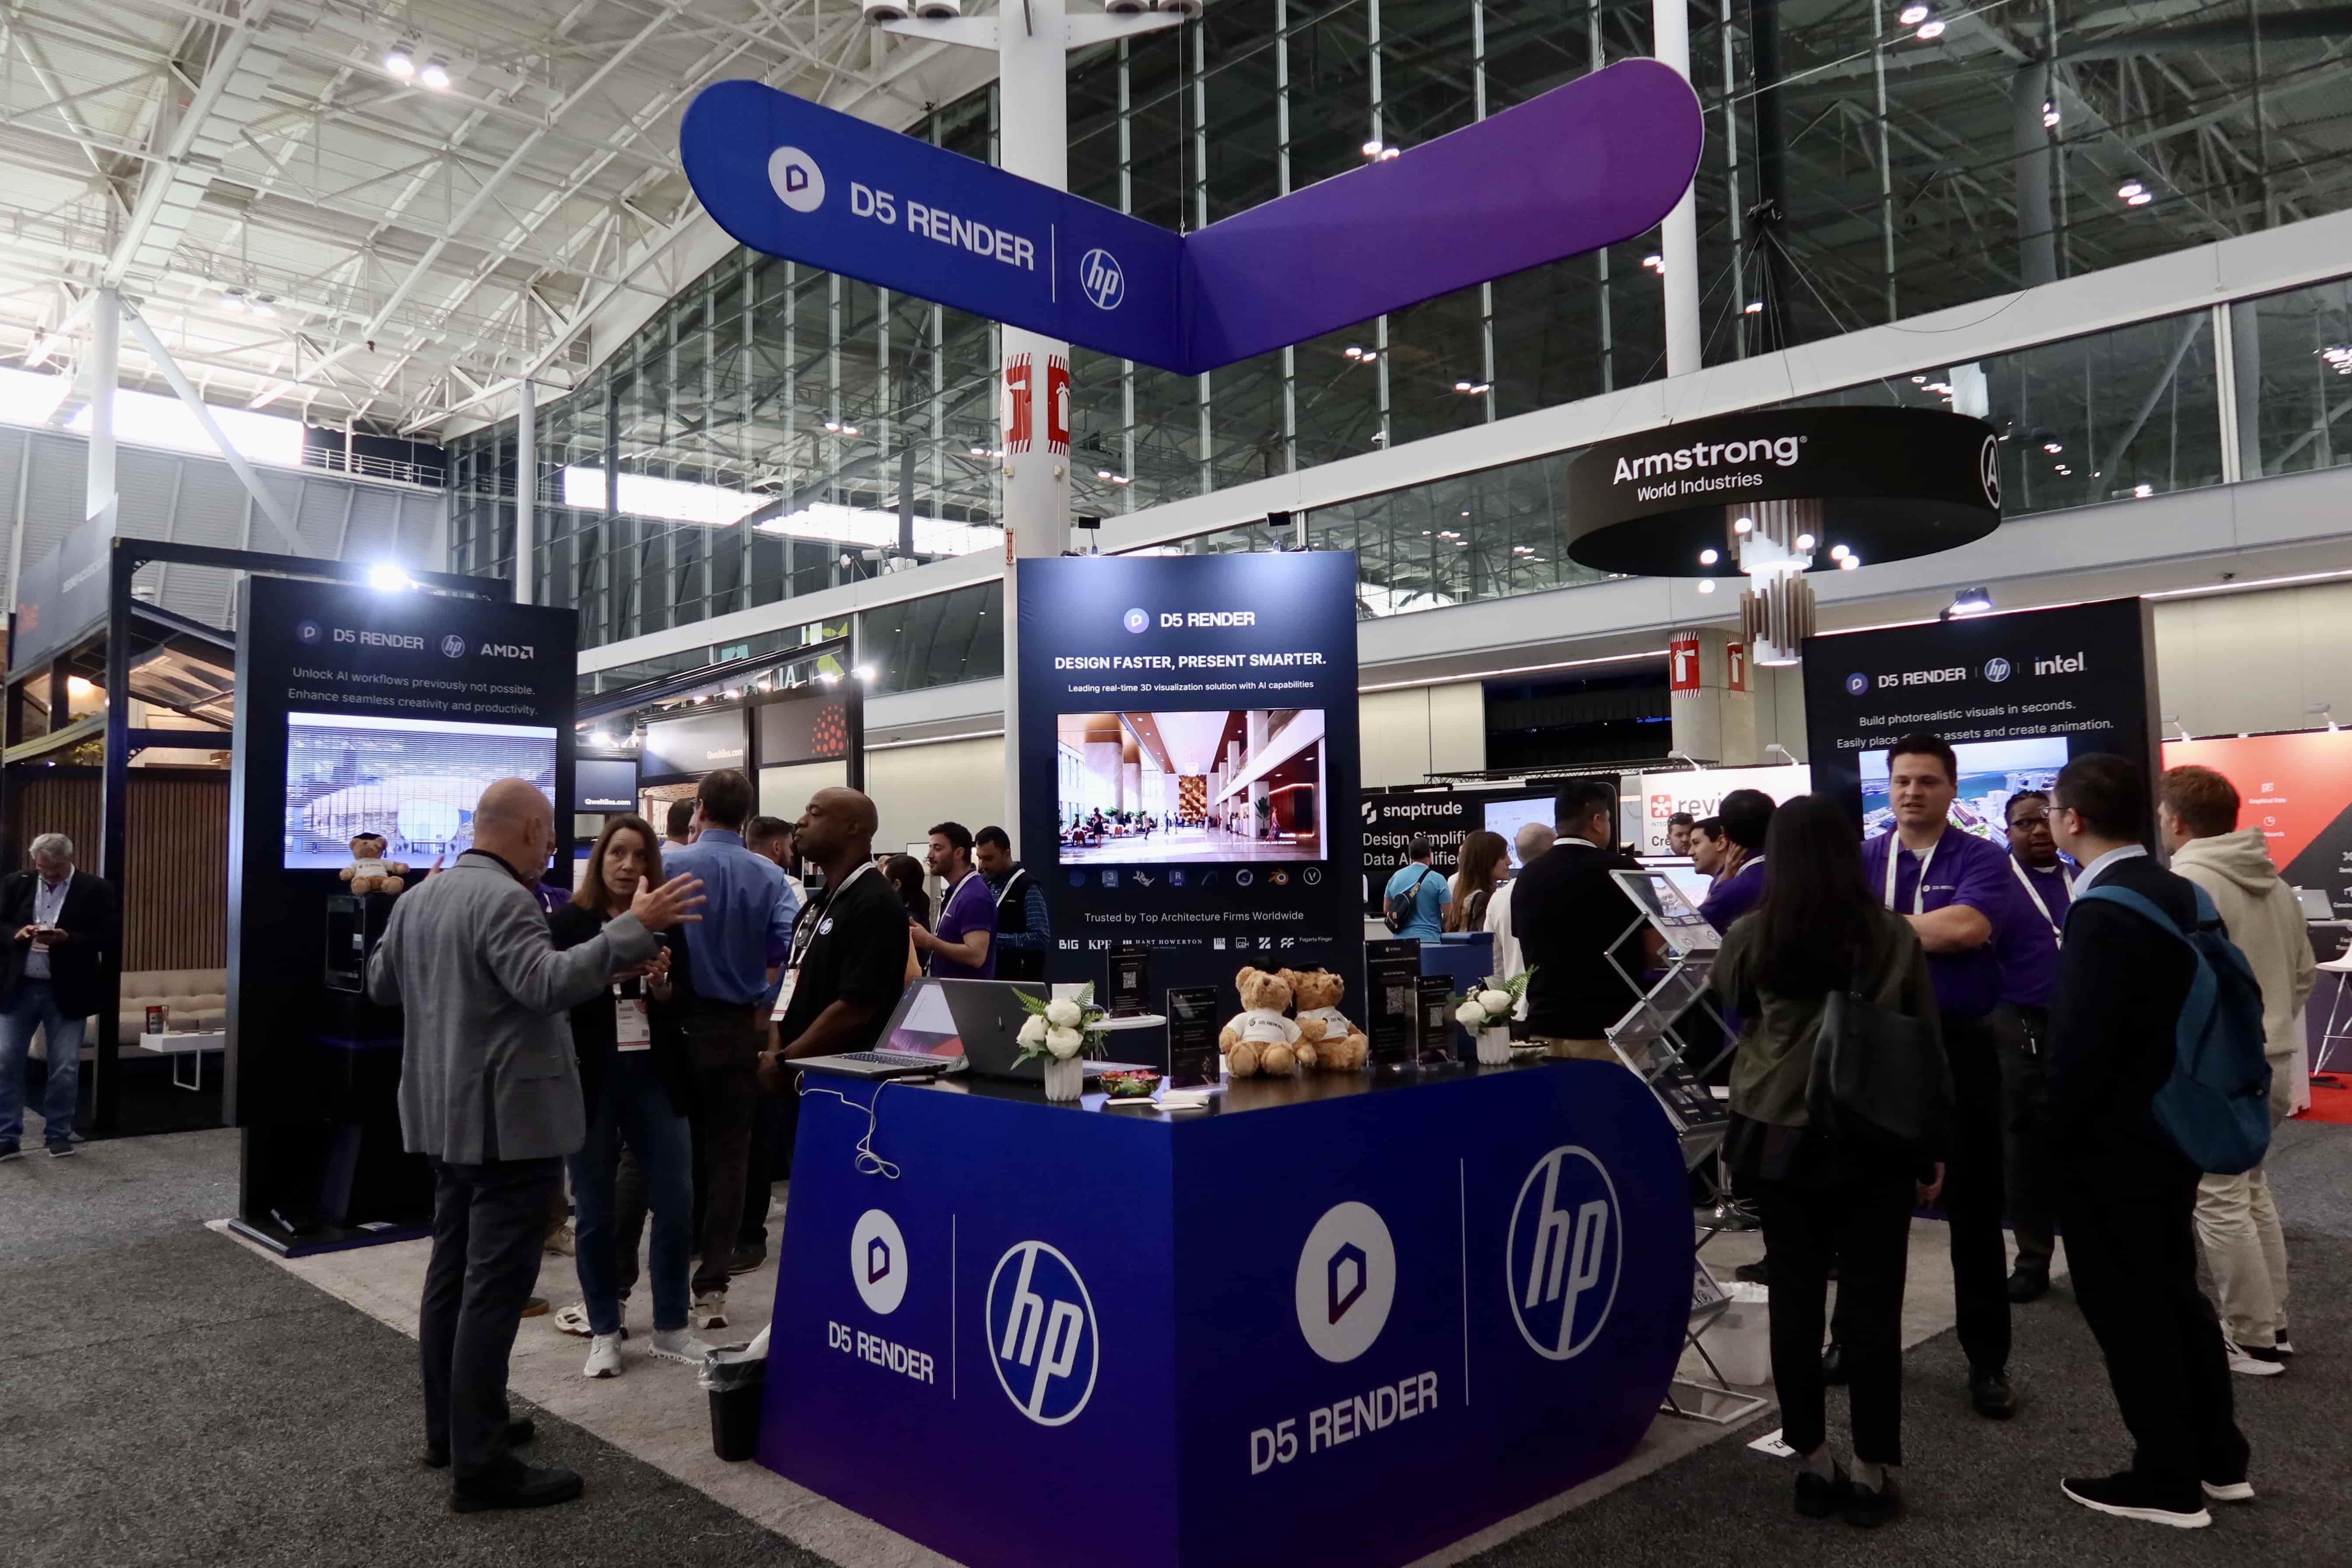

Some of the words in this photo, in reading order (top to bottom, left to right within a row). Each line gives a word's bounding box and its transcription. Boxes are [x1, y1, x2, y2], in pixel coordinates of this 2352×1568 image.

[851, 182, 896, 224] D5
[908, 200, 1034, 270] RENDER
[1082, 249, 1122, 309] hp
[1638, 482, 1676, 502] World
[1682, 473, 1762, 494] Industries
[1161, 614, 1183, 627] D5
[1188, 611, 1255, 627] RENDER
[334, 628, 355, 642] D5
[361, 631, 424, 649] RENDER
[441, 635, 465, 658] hp
[481, 644, 519, 659] AMD
[1055, 657, 1109, 669] DESIGN
[1113, 656, 1175, 670] FASTER,
[1179, 655, 1246, 667] PRESENT
[1250, 653, 1326, 666] SMARTER.
[1878, 674, 1899, 688] D5
[1903, 668, 1966, 685] RENDER
[1984, 658, 2010, 682] hp
[293, 667, 333, 679] Unlock
[337, 671, 348, 681] AI
[351, 674, 409, 686] workflows
[412, 679, 467, 692] previously
[490, 685, 535, 695] possible.
[1069, 684, 1100, 693] Leading
[1269, 681, 1313, 690] capabilities
[288, 688, 339, 701] Enhance
[343, 695, 394, 705] seamless
[398, 699, 448, 711] creativity
[452, 702, 471, 710] and
[474, 704, 537, 716] productivity.
[1860, 716, 1885, 726] Build
[1889, 709, 1962, 726] photorealistic
[1966, 706, 2004, 717] visuals
[2008, 705, 2018, 713] in
[2022, 700, 2075, 712] seconds.
[1837, 738, 1866, 748] Easily
[1870, 737, 1898, 747] place
[1944, 730, 1980, 740] assets
[1984, 726, 2005, 737] and
[2009, 725, 2047, 735] create
[2050, 719, 2113, 732] animation.
[1384, 801, 1462, 820] snaptrude
[1363, 832, 1409, 848] Design
[1364, 853, 1394, 866] Data
[1085, 913, 1121, 922] Trusted
[1125, 914, 1136, 923] by
[1140, 913, 1158, 923] Top
[1161, 913, 1220, 921] Architecture
[1224, 912, 1249, 921] Firms
[1253, 911, 1303, 920] Worldwide
[1059, 940, 1078, 949] BIG
[1510, 1145, 1619, 1360] hp
[989, 1240, 1095, 1426] hp
[829, 1321, 852, 1352] D5
[858, 1331, 933, 1384] RENDER
[1251, 1418, 1298, 1475] D5
[1310, 1371, 1437, 1453] RENDER
